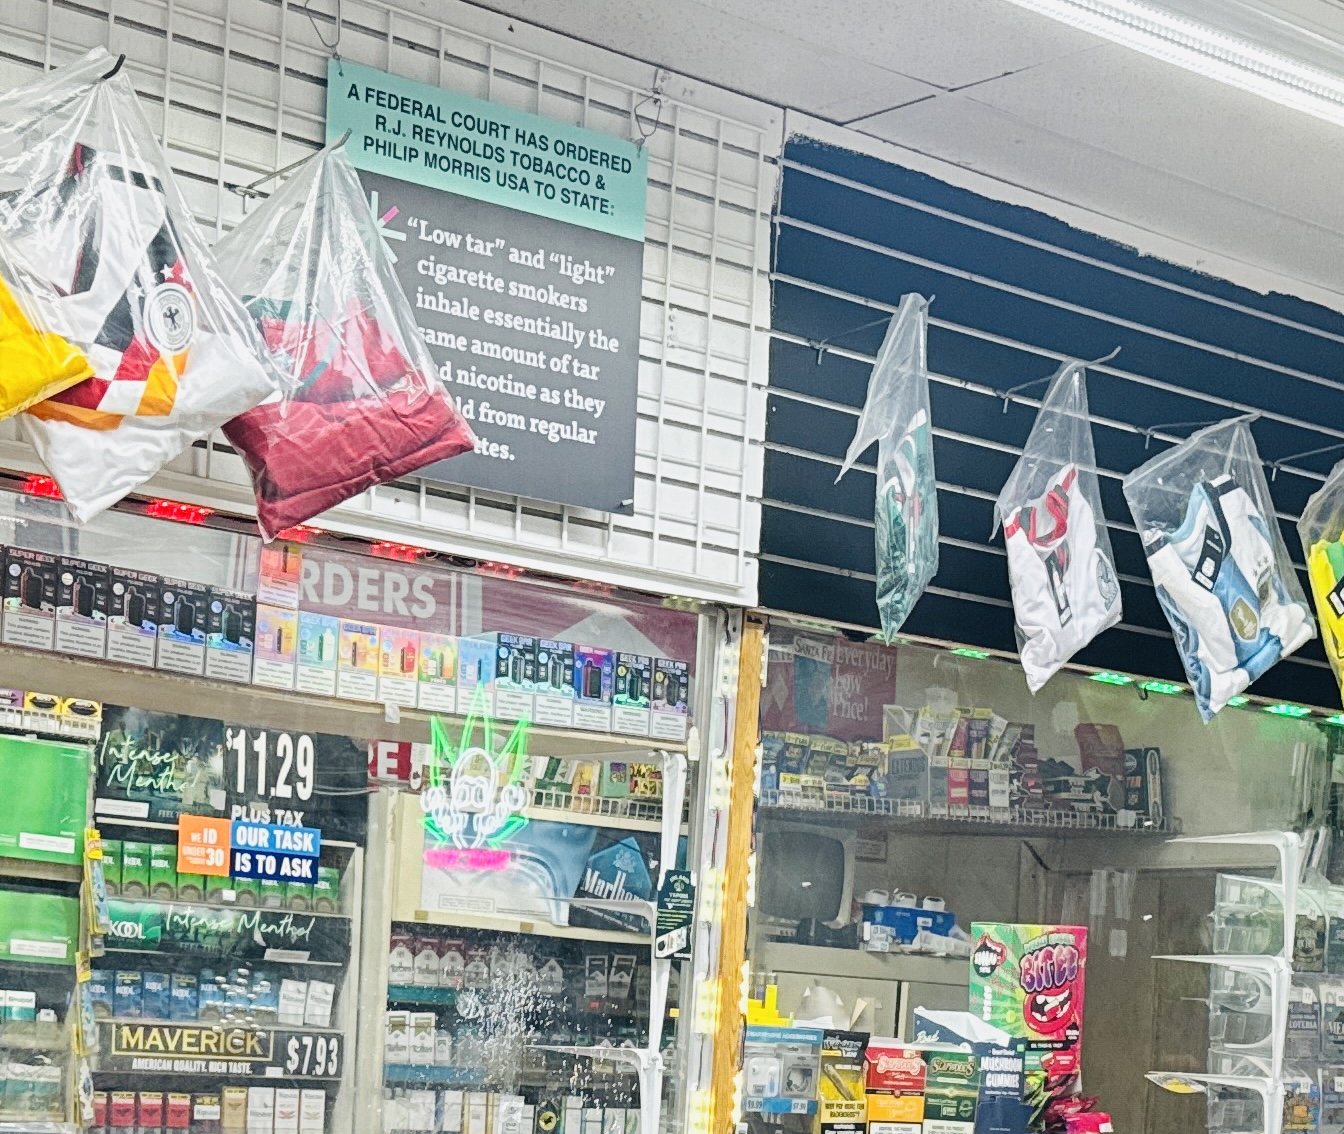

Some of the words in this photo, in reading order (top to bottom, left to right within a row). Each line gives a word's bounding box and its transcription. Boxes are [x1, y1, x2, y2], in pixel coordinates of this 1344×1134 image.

[348, 84, 360, 101] A
[365, 87, 446, 124] FEDERAL
[451, 112, 510, 140] COURT
[515, 128, 549, 151] HAS
[554, 140, 632, 174] ORDERED
[375, 115, 406, 137] R.J.
[412, 124, 505, 163] REYNOLDS
[510, 151, 590, 186] TOBACCO
[595, 175, 605, 190] &
[364, 135, 419, 163] PHILIP
[424, 151, 491, 183] MORRIS
[497, 170, 529, 193] USA
[534, 180, 556, 199] TO
[560, 188, 615, 216] STATE:
[509, 248, 545, 269] and
[418, 255, 504, 292] cigarette
[508, 281, 588, 312] smokers
[416, 287, 480, 321] inhale
[484, 309, 585, 349] essentially
[589, 329, 619, 353] the
[418, 327, 467, 351] same
[471, 339, 546, 369] amount
[550, 355, 572, 374] of
[573, 358, 600, 380] tar
[457, 366, 537, 399] nicotine
[540, 387, 561, 405] as
[564, 388, 605, 418] they
[479, 402, 526, 430] from
[530, 418, 598, 445] regular
[834, 638, 892, 679] Everyday
[226, 728, 314, 801] $11.29
[203, 828, 217, 845] ID
[232, 805, 272, 824] PLUS
[275, 809, 304, 828] TAX
[206, 849, 224, 866] 30
[236, 826, 268, 848] OUR
[274, 829, 314, 852] TASK
[235, 853, 251, 872] IS
[256, 855, 275, 874] TO
[280, 858, 313, 878] ASK
[109, 921, 146, 939] KOOL
[121, 1026, 262, 1055] MAVERICK
[287, 1035, 338, 1076] $7.93
[132, 1058, 172, 1071] AMERICAN
[208, 1061, 227, 1073] RICH
